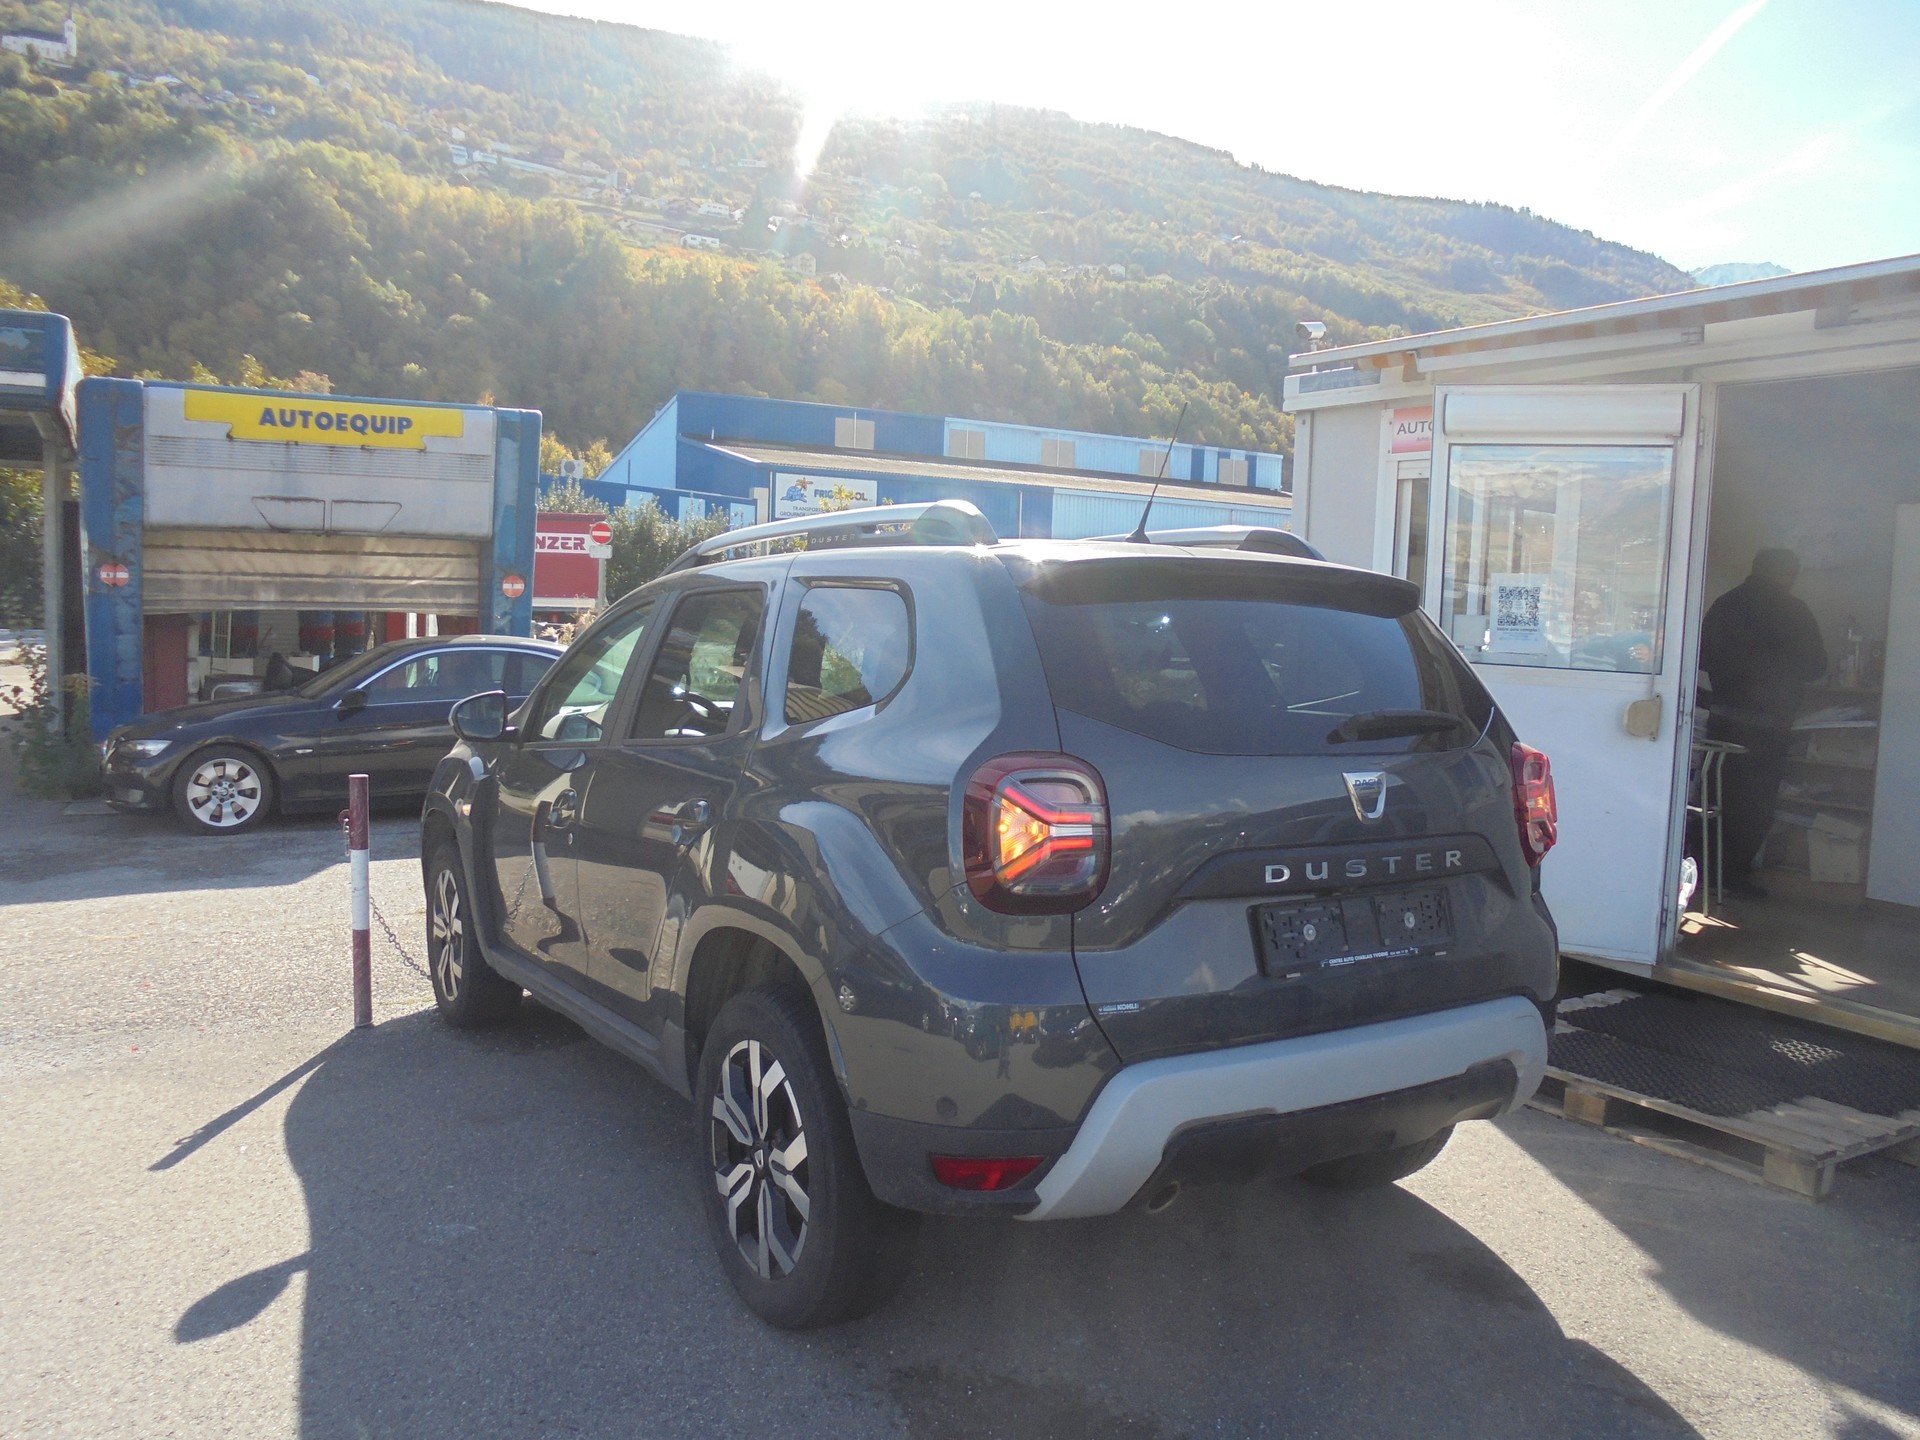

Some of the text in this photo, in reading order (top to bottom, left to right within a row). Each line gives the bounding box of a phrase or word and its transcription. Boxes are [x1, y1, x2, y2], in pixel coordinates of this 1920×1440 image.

[259, 407, 413, 435] AUTOEQUIP
[811, 534, 855, 544] DUSTER
[1354, 779, 1383, 787] DACIA
[1265, 850, 1462, 884] DUSTER
